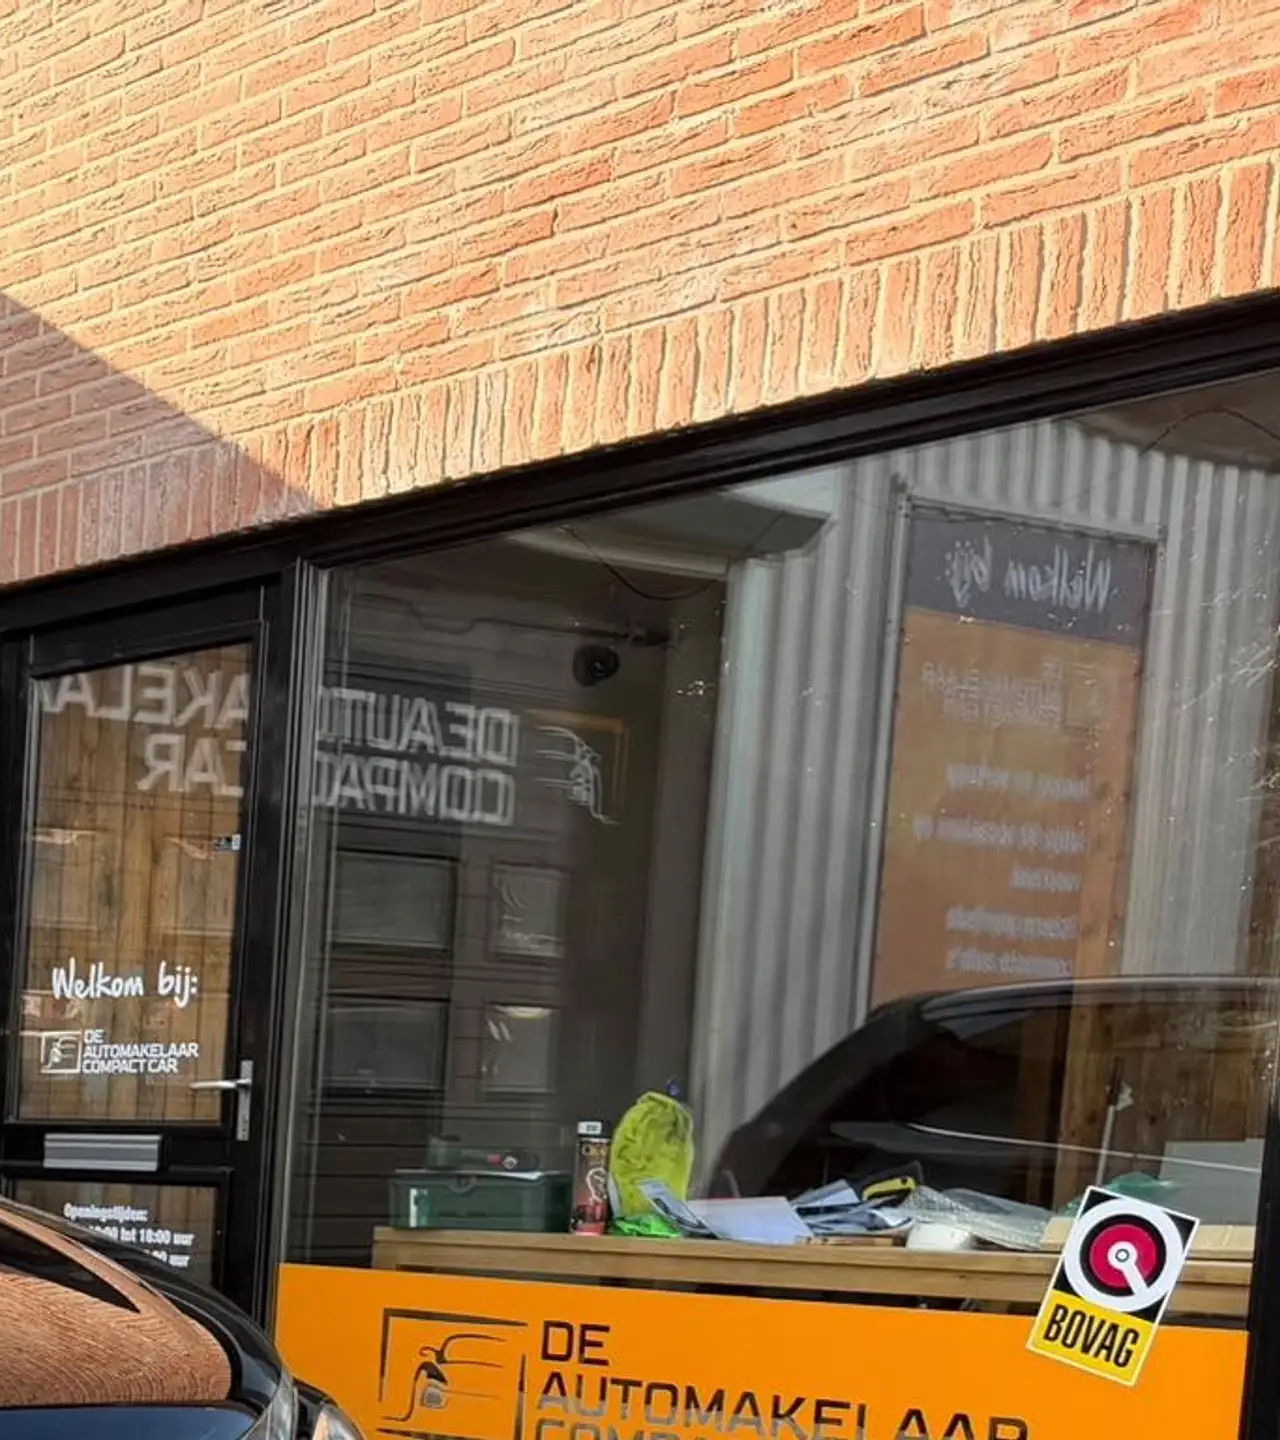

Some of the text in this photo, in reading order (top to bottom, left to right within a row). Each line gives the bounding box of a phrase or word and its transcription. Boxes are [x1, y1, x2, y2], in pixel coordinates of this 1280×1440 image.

[52, 956, 198, 1008] Welkom bij:
[83, 1029, 105, 1044] DE
[83, 1042, 200, 1059] AUTOMAKELAAR
[147, 1058, 178, 1074] CAR
[541, 1320, 610, 1366] DE
[1044, 1304, 1140, 1368] BOVAG
